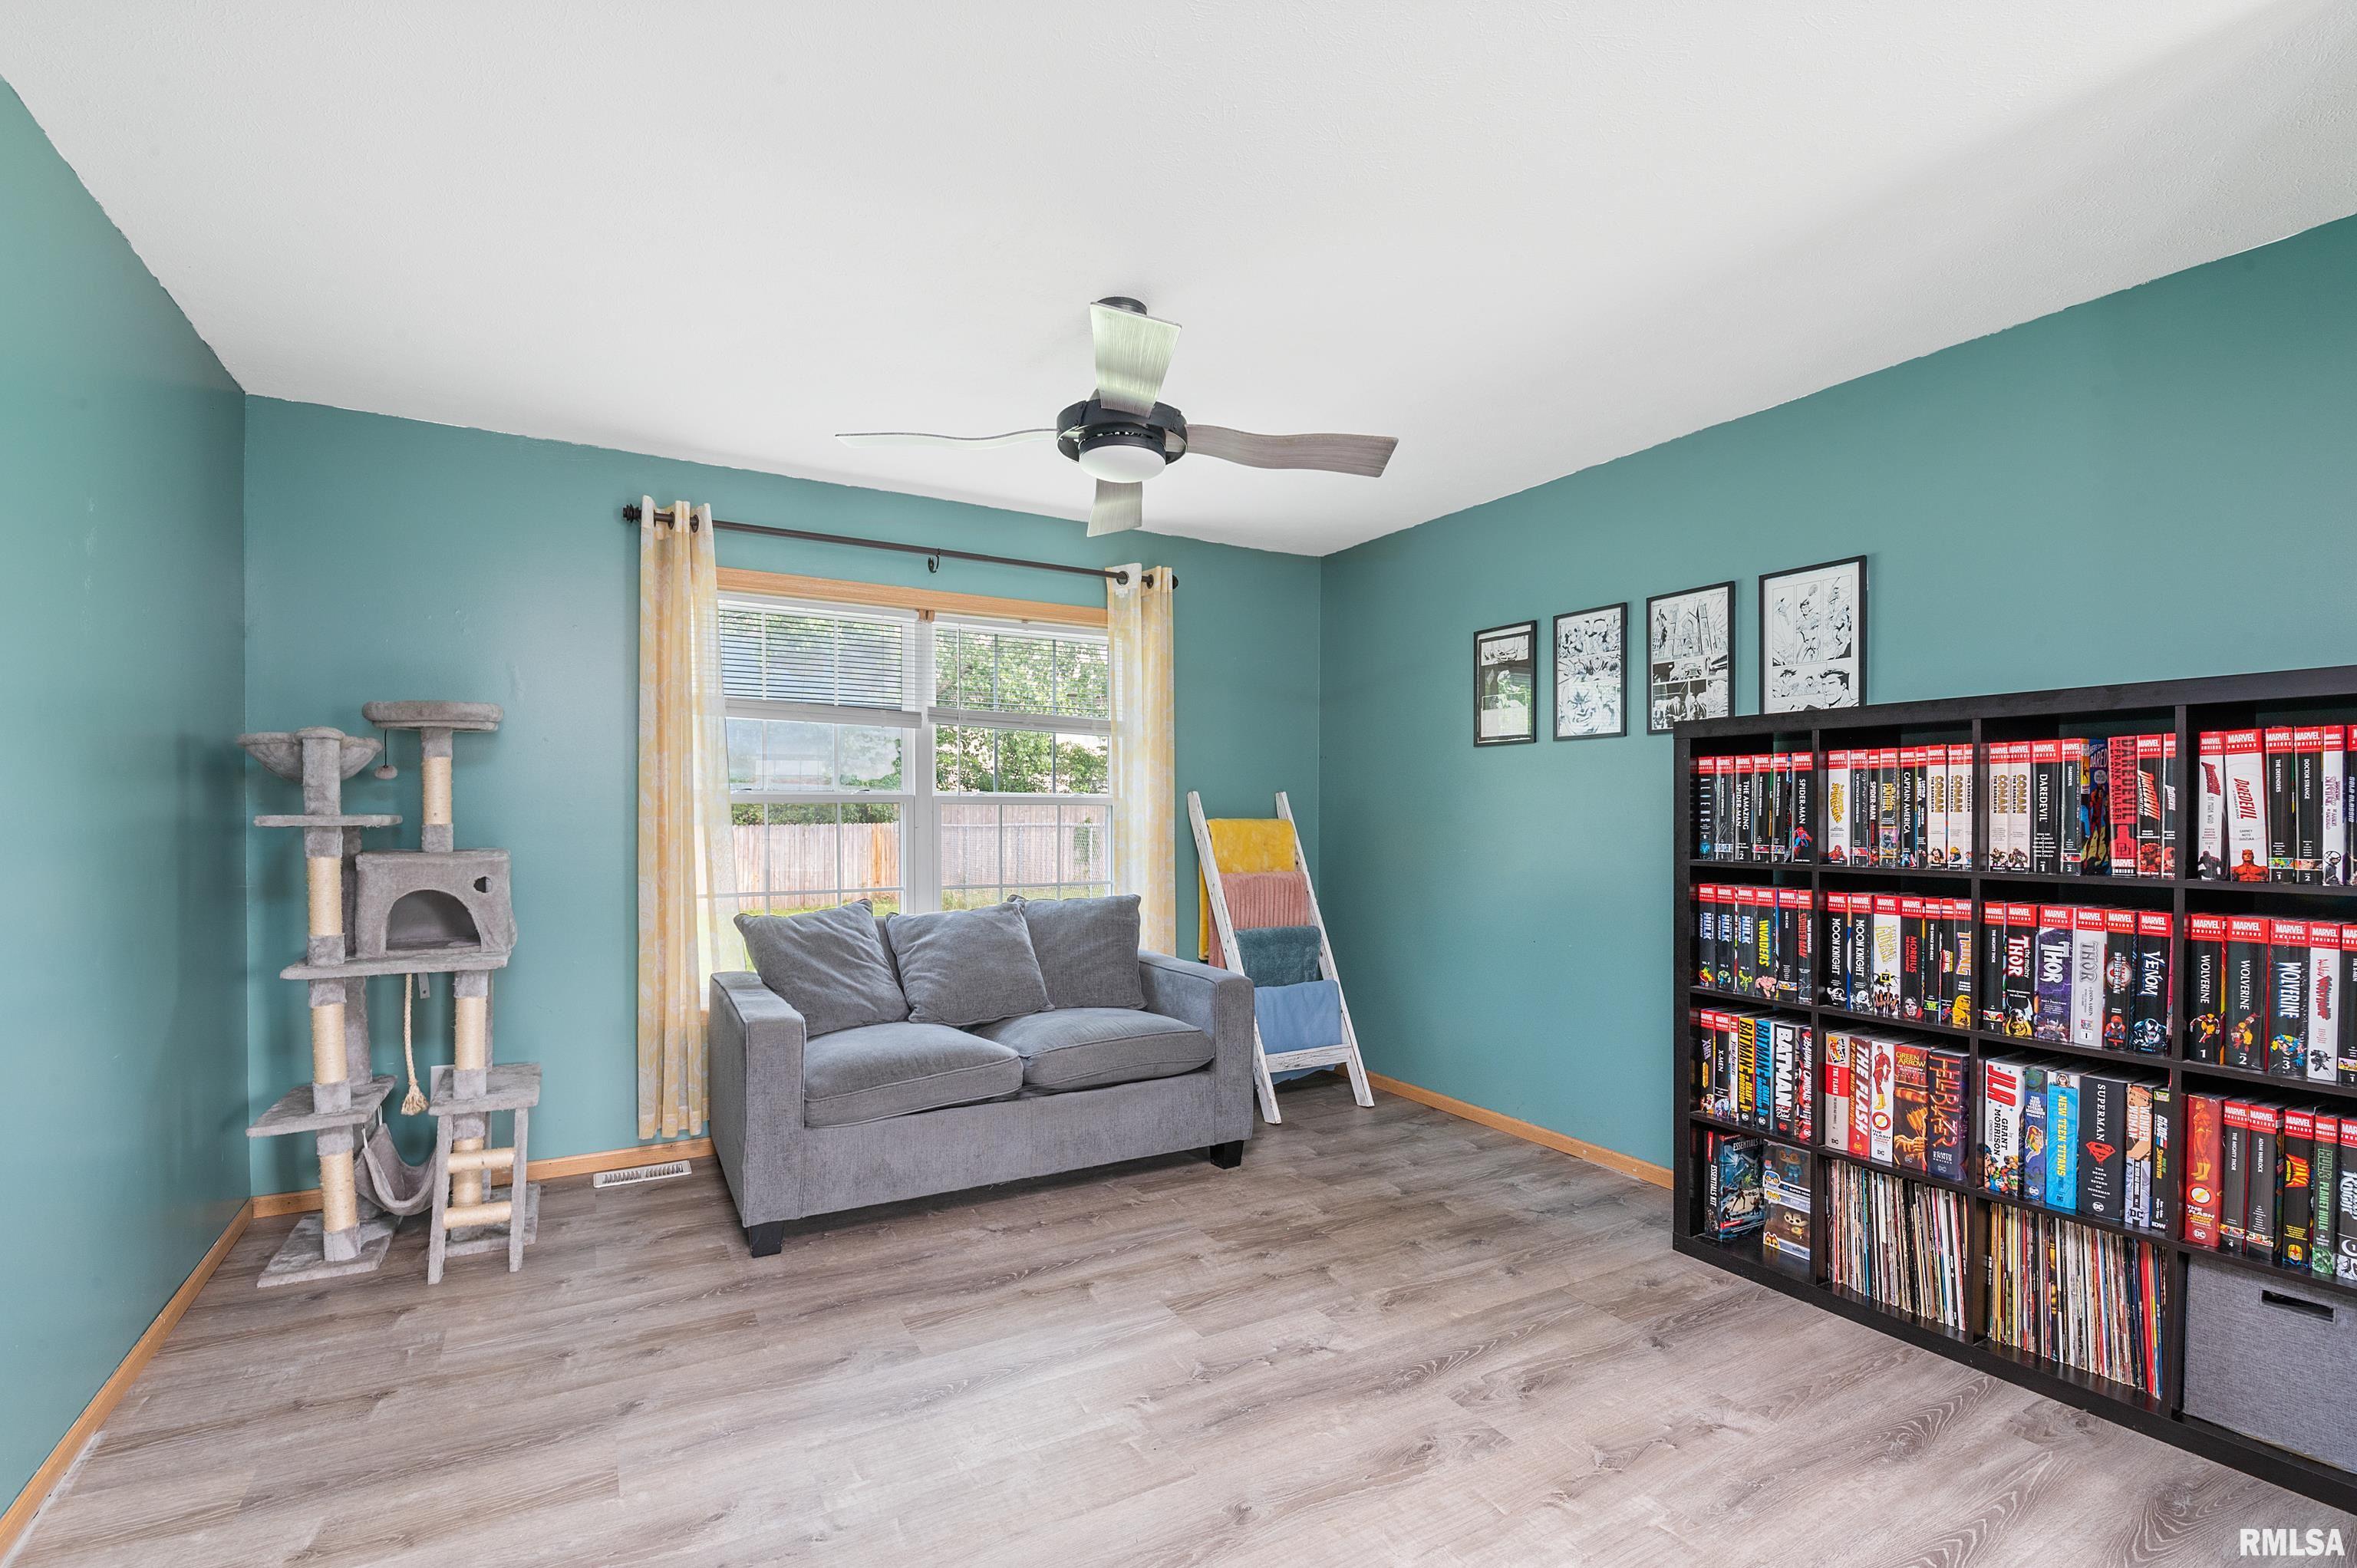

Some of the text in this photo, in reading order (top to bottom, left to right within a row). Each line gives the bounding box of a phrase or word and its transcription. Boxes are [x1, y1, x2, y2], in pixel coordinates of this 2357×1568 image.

[2228, 732, 2256, 743] MARVEL
[2266, 732, 2291, 741] MARVEL
[2294, 731, 2320, 740] MARVEL
[1935, 776, 1944, 813] CONAN
[1953, 775, 1963, 812] CONAN
[1998, 775, 2008, 814] CONAN
[2016, 774, 2027, 814] CONAN
[2121, 740, 2136, 820] DAREDEVIL
[1699, 778, 1711, 822] ALIENS
[1882, 783, 1894, 811] PANTHER
[2039, 774, 2049, 822] DAREDEVIL
[2233, 778, 2257, 819] DAREDEVIL
[2111, 858, 2135, 867] MARVEL
[1742, 916, 1751, 945] HULK
[2045, 910, 2067, 919] MARVEL
[2078, 911, 2101, 921] MARVEL
[2108, 913, 2132, 923] MARVEL
[2141, 914, 2166, 925] MARVEL
[2193, 919, 2220, 929] MARVEL
[2233, 921, 2260, 931] MARVEL
[2276, 924, 2303, 934] MARVEL
[1759, 920, 1769, 967] INVADERS
[1798, 913, 1808, 958] SPIDER-MAN
[1832, 918, 1841, 946] MOON
[1855, 919, 1864, 947] MOON
[1875, 927, 1892, 964] MUTANTS
[2312, 928, 2338, 937] MARVEL
[1855, 947, 1864, 977] KNIGHT
[1956, 931, 1972, 976] THING
[2009, 934, 2030, 977] THOR
[2041, 940, 2072, 983] THOR
[2079, 942, 2099, 983] THOR
[2113, 952, 2121, 994] SPIDER-MAN
[2141, 951, 2165, 997] VENOM
[2200, 954, 2210, 1004] WOLVERINE
[2240, 960, 2250, 1010] WOLVERINE
[2277, 962, 2302, 1019] WOLVERINE
[1739, 1020, 1752, 1069] BATMAN
[1756, 1023, 1770, 1072] BATMAN
[1895, 1051, 1920, 1061] GREEN
[2200, 1049, 2207, 1059] 1
[2239, 1056, 2247, 1065] 2
[1775, 1027, 1792, 1108] BATMAN
[1897, 1057, 1926, 1068] ARROW
[2282, 1060, 2290, 1069] 3
[1855, 1043, 1869, 1136] THE FLASH
[1987, 1064, 2016, 1106] JLA
[1929, 1055, 1960, 1148] HELLBLAZER
[2059, 1095, 2067, 1117] NEW
[2096, 1083, 2106, 1141] SUPERMAN
[2225, 1106, 2247, 1116] MARVEL
[2250, 1110, 2274, 1122] MARVEL
[2058, 1117, 2067, 1143] TEEN
[2128, 1106, 2139, 1138] WOMAN
[2139, 1106, 2150, 1141] WONDER
[2286, 1115, 2311, 1128] MARVEL
[1732, 1138, 1759, 1151] ESSENTIALS
[2056, 1145, 2067, 1177] TITANS
[2286, 1154, 2309, 1188] NOVA
[2317, 1148, 2332, 1230] HULK PLANET HULK
[2130, 1207, 2144, 1220] DC
[2188, 1209, 2214, 1218] FLASH
